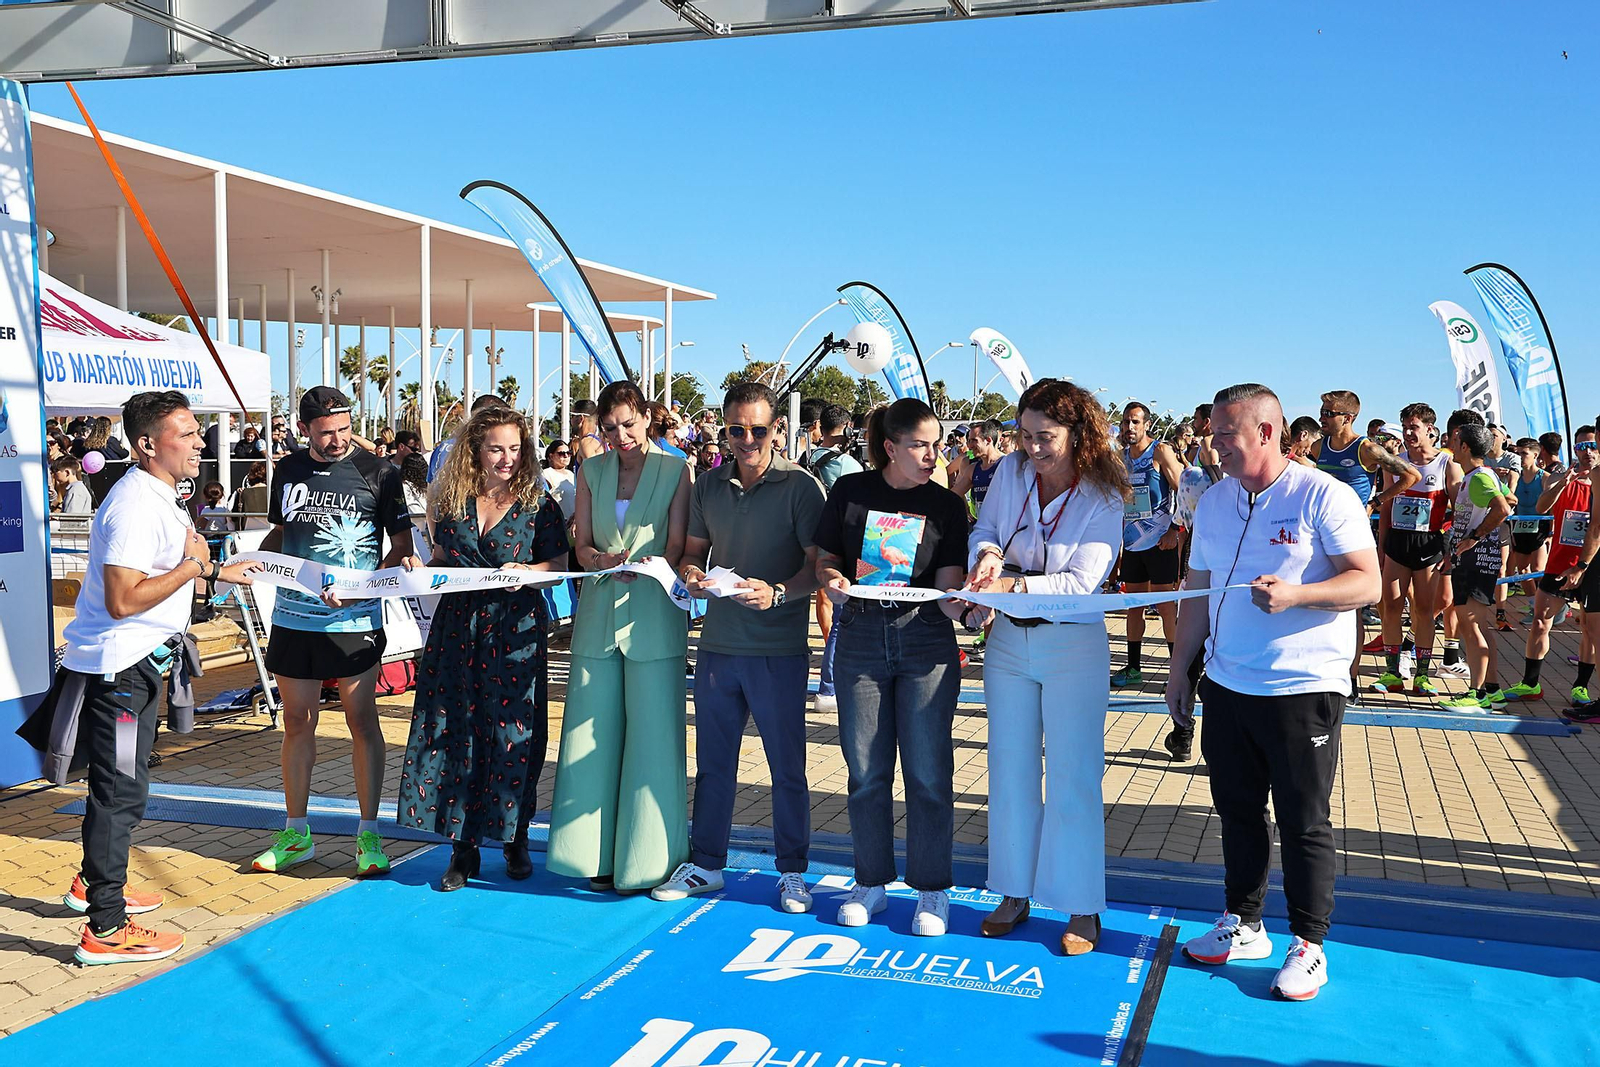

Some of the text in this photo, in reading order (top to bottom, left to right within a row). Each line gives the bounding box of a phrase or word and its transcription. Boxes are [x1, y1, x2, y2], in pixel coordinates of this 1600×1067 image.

[43, 350, 203, 390] UB MARATÓN HUELVA
[304, 491, 357, 511] HUELVA
[297, 513, 329, 524] AVATE
[1402, 505, 1419, 517] 24
[876, 516, 908, 530] NIKE
[1518, 521, 1535, 532] 162
[366, 577, 400, 589] AVATEL
[479, 575, 521, 583] AVATEL
[580, 949, 654, 1000] www.10khuelva.es
[848, 947, 1045, 988] HUELVA
[841, 967, 1043, 998] PUERTA DEL DESCUBRIMIENTO
[1101, 1001, 1132, 1066] www.10khuelva.es
